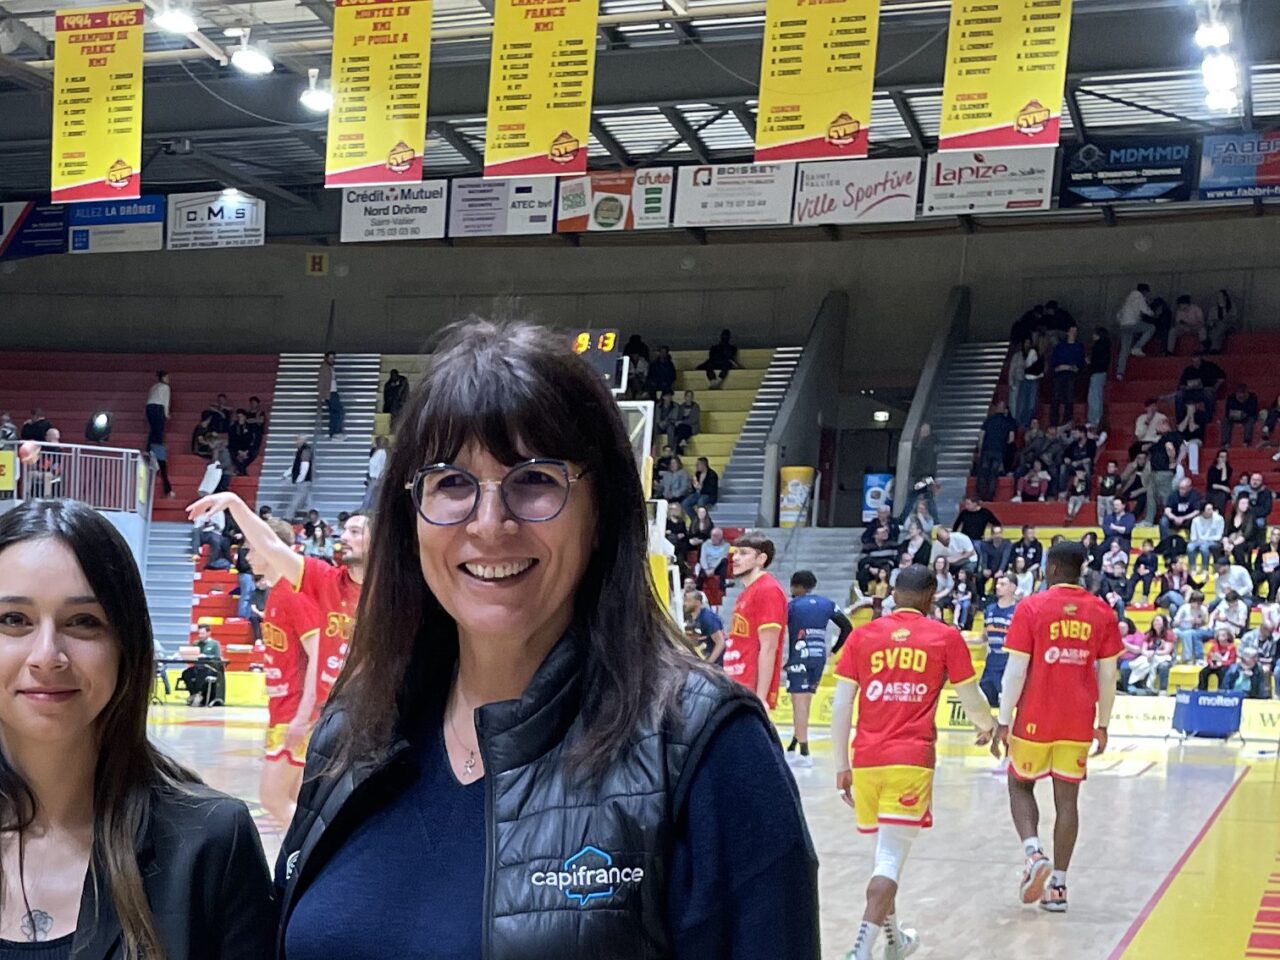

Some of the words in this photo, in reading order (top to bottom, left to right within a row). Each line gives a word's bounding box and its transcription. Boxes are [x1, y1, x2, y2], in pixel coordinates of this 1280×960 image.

[717, 165, 776, 175] BOISSET
[346, 190, 385, 204] Crédit
[400, 186, 443, 201] Mutuel
[797, 194, 837, 222] Ville
[842, 169, 915, 211] Sportive
[363, 206, 390, 216] Nord
[392, 204, 428, 215] Drôme
[510, 200, 536, 209] ATEC
[75, 207, 103, 219] ALLEZ
[104, 206, 118, 217] LA
[1049, 619, 1092, 641] SVBD
[871, 647, 928, 674] SVBD
[1198, 695, 1239, 707] molten
[531, 865, 645, 893] capifrance
